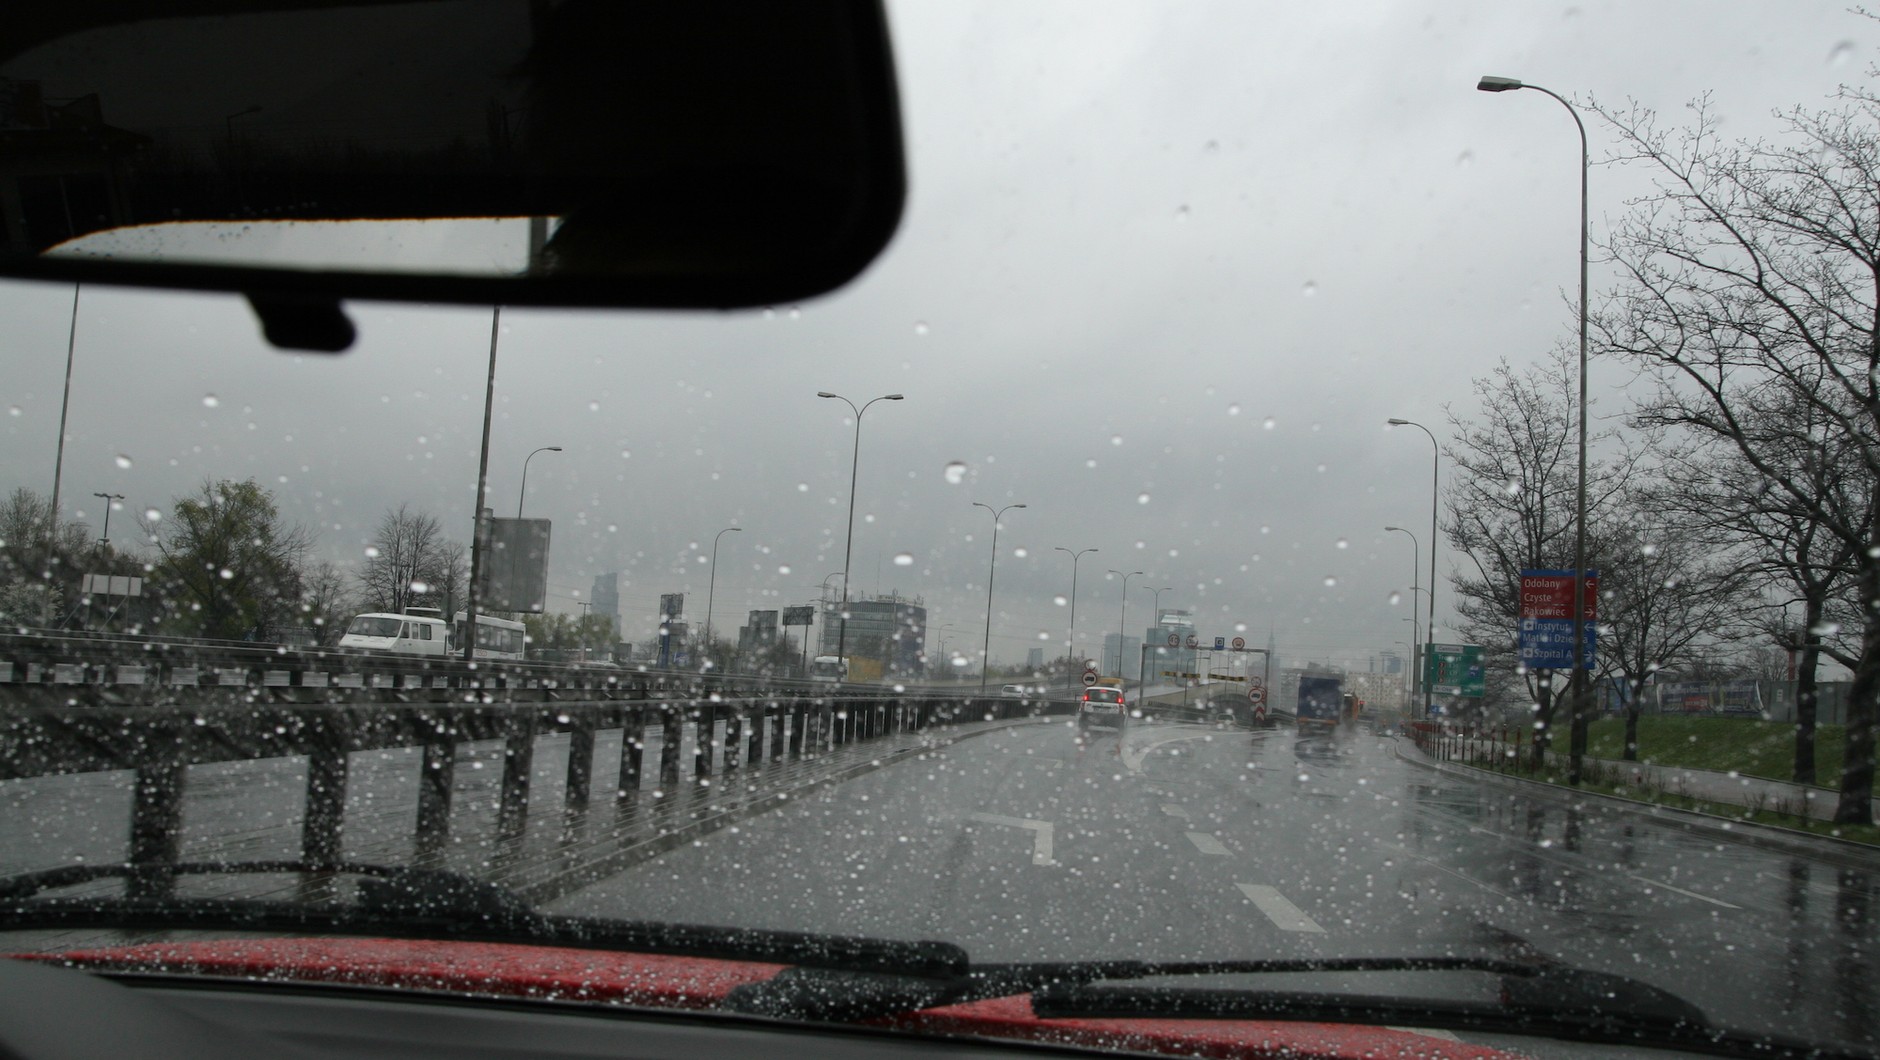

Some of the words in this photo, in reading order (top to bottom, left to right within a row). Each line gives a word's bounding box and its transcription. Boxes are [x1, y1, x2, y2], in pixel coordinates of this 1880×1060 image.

[1524, 579, 1560, 589] Odolany
[1524, 592, 1552, 603] Czyste
[1523, 606, 1566, 616] Rakowiec
[1534, 648, 1563, 659] Szpital
